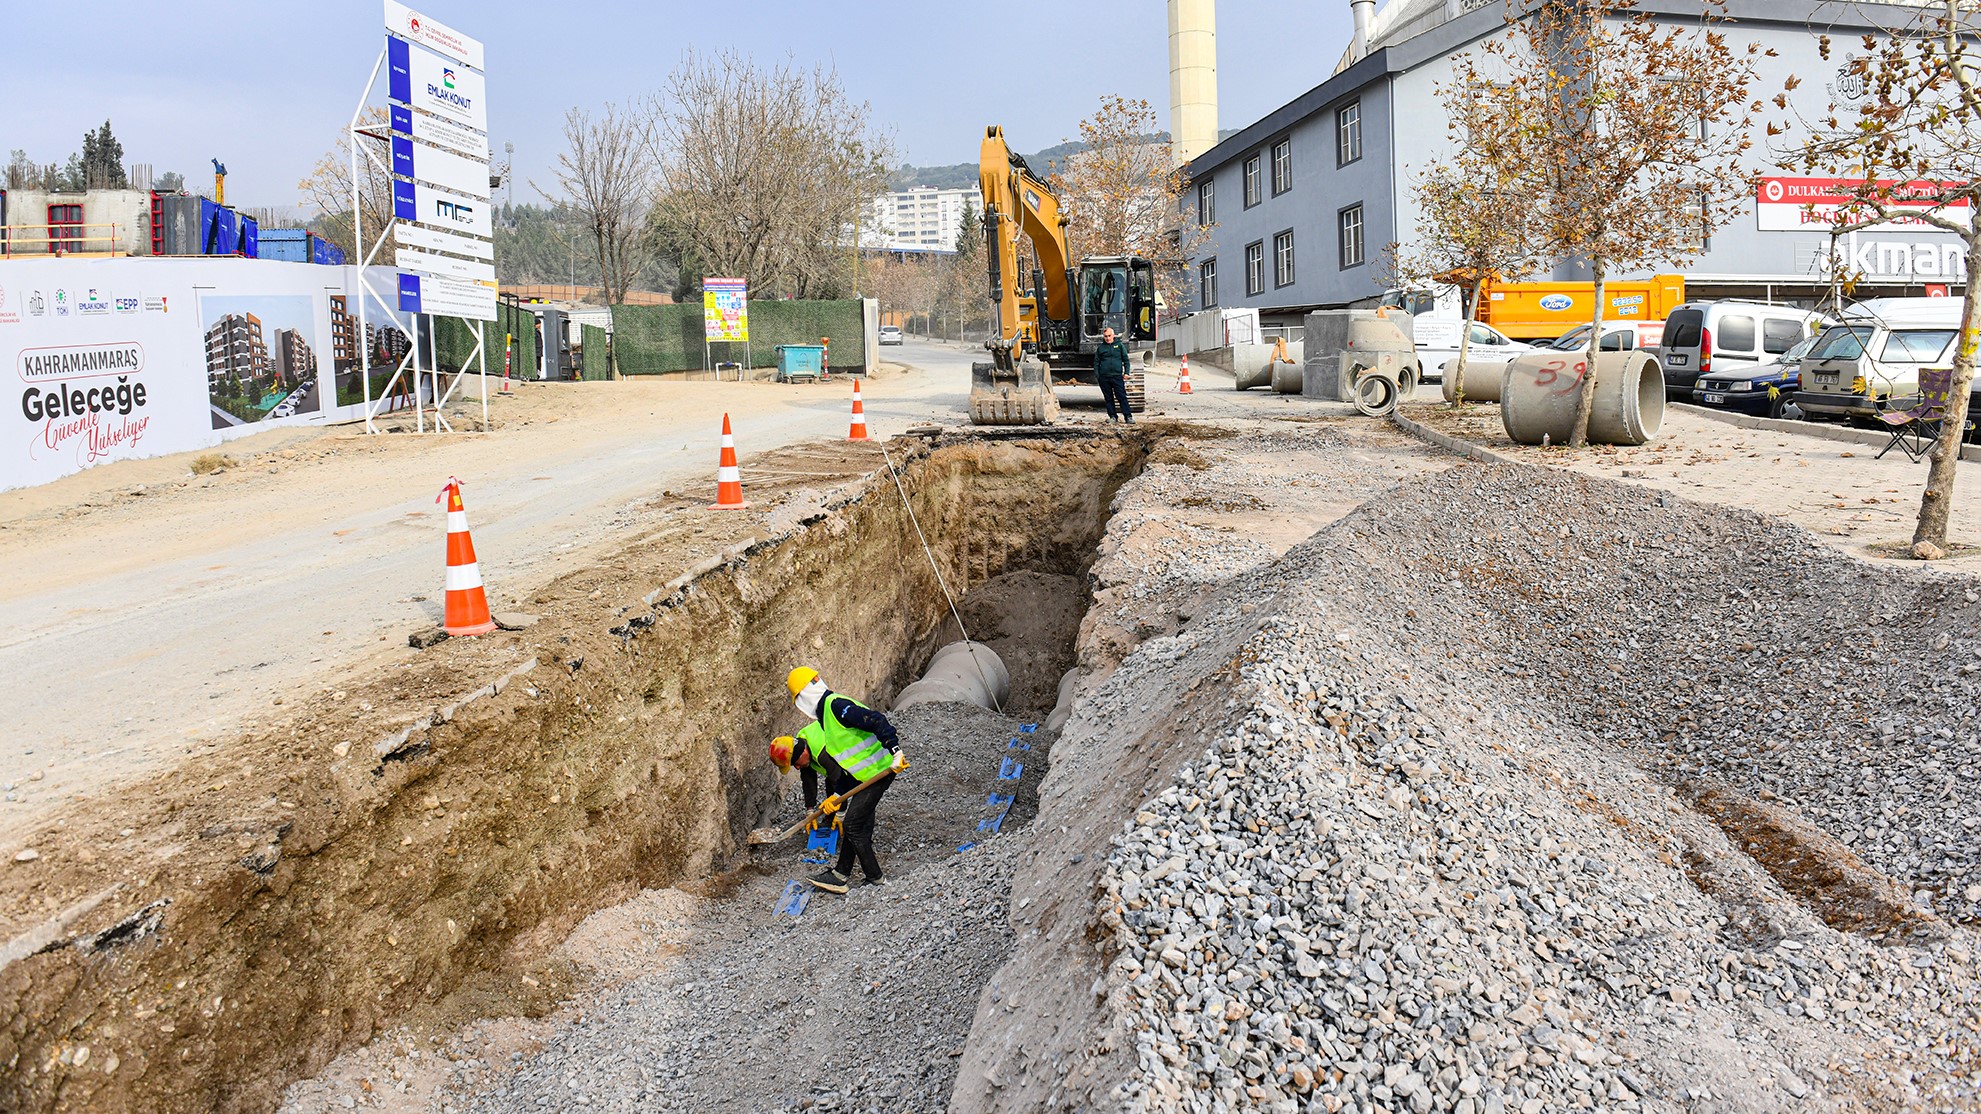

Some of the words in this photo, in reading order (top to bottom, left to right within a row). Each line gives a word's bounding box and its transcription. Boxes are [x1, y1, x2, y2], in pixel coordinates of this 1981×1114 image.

[427, 83, 449, 102] EMLAK
[449, 92, 471, 109] KONUT
[79, 302, 93, 310] EMLAK
[93, 302, 109, 310] KONUT
[123, 298, 138, 310] EPP
[1545, 296, 1567, 309] Ford
[25, 349, 138, 375] KAHRAMANMARAŞ
[22, 376, 147, 421] Geleceğe
[29, 405, 100, 461] Güvenle
[76, 416, 150, 468] Yükseliyor
